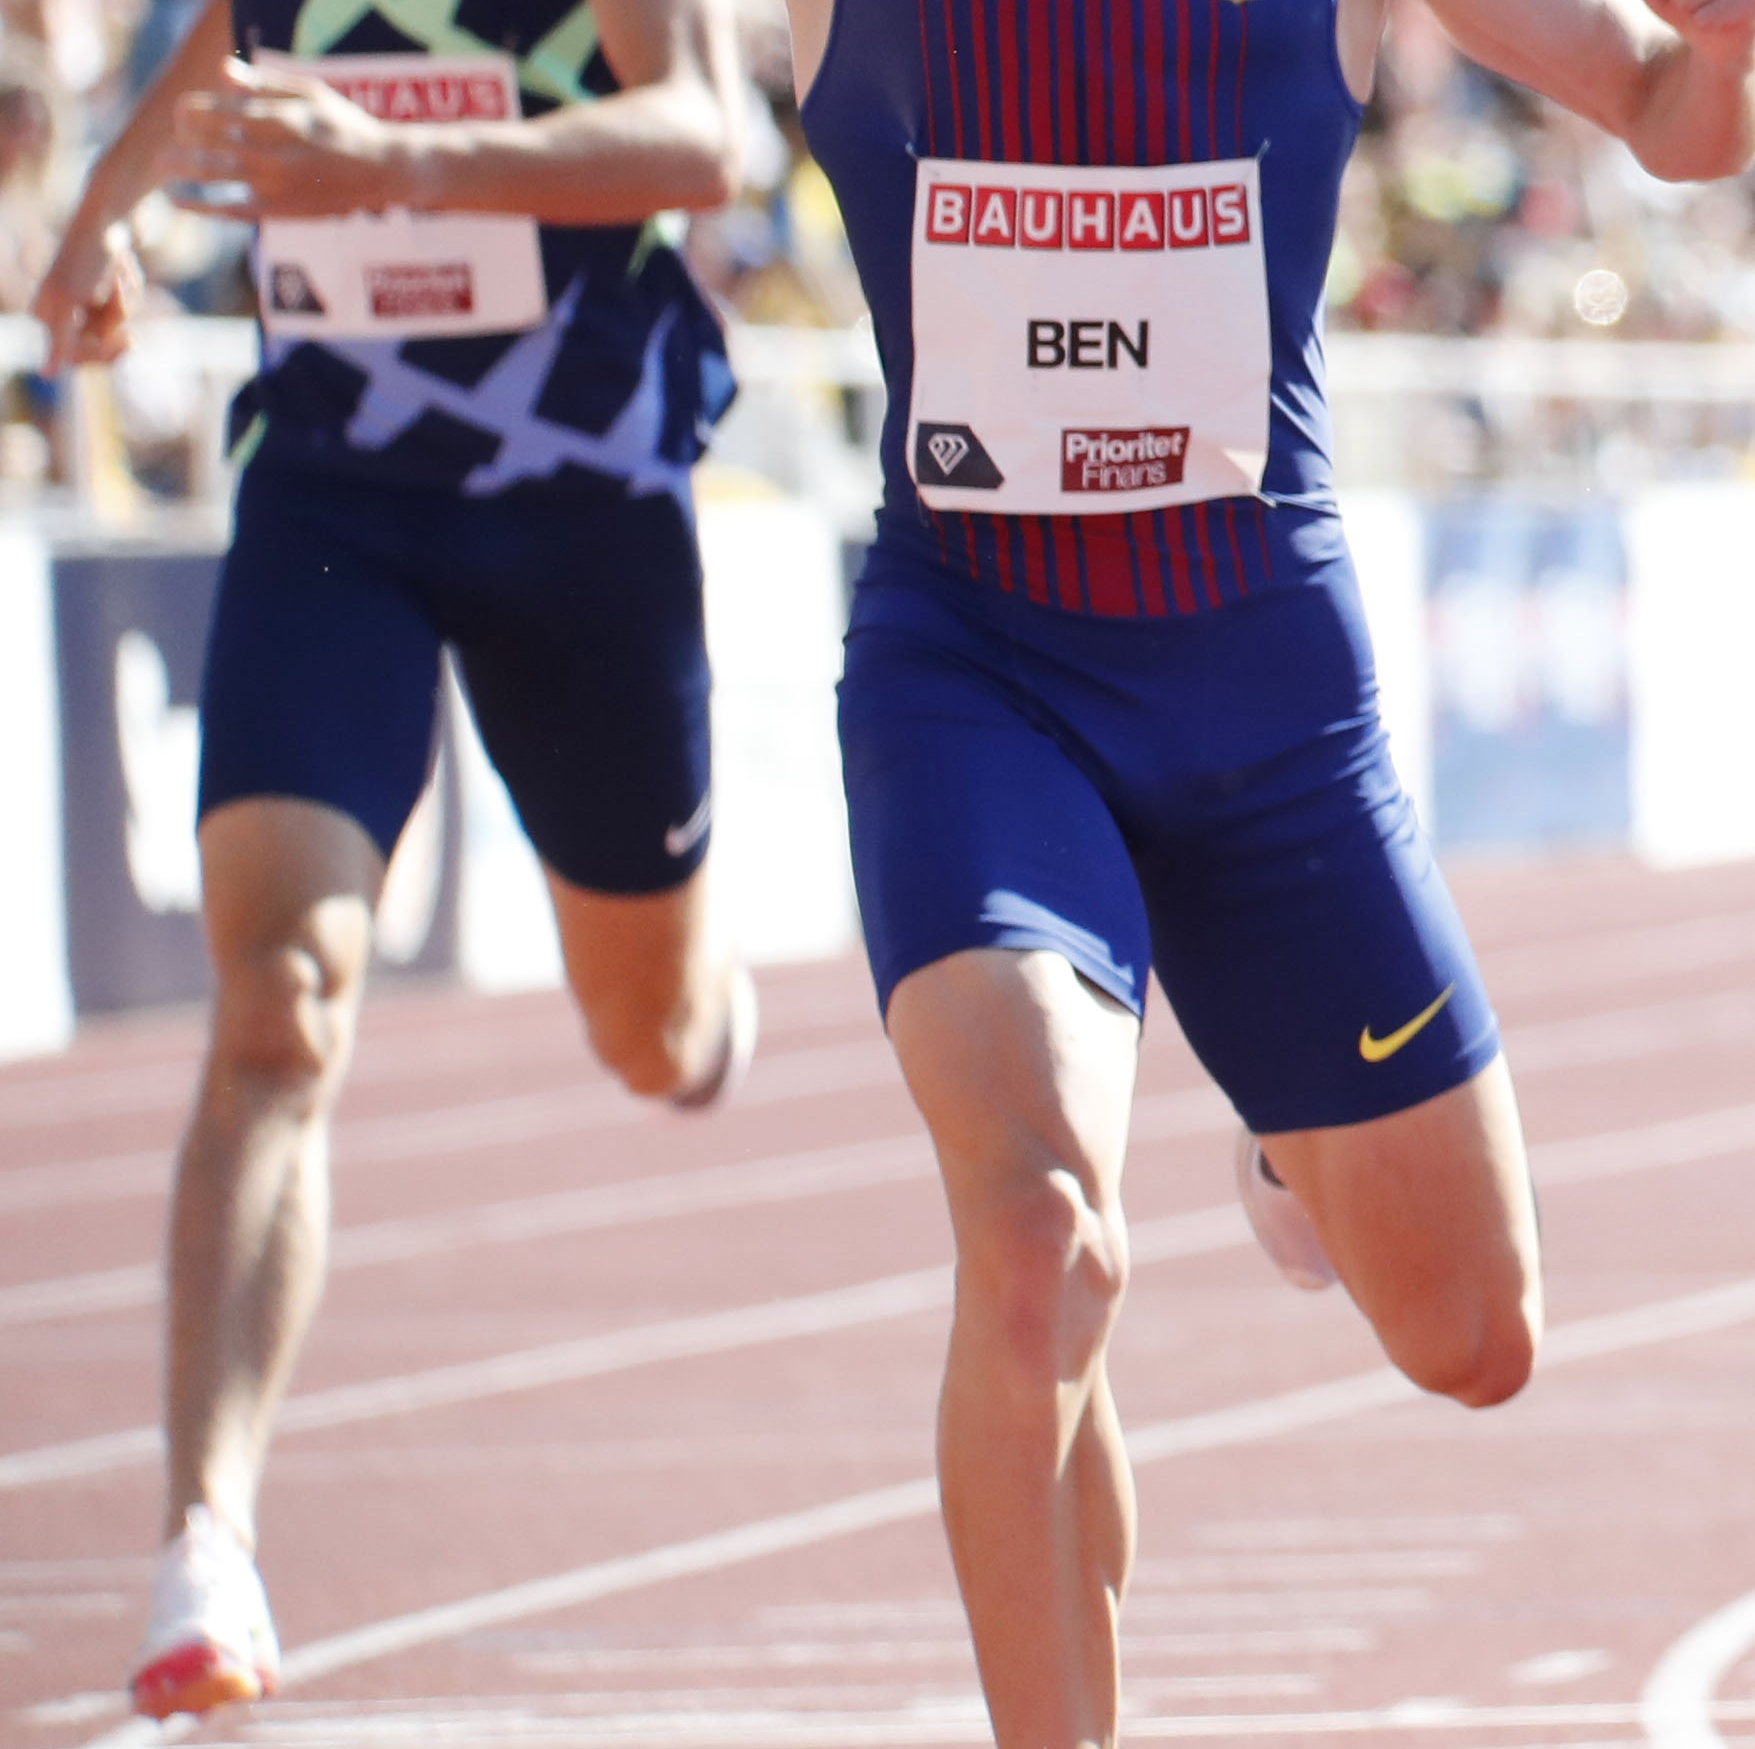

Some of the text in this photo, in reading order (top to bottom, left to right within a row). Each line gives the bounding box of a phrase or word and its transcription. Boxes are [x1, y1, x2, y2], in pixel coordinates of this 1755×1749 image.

[930, 188, 1247, 242] BAUHAUS
[1026, 318, 1150, 369] BEN
[1065, 432, 1185, 469] Prioritet
[1081, 459, 1167, 489] Finans
